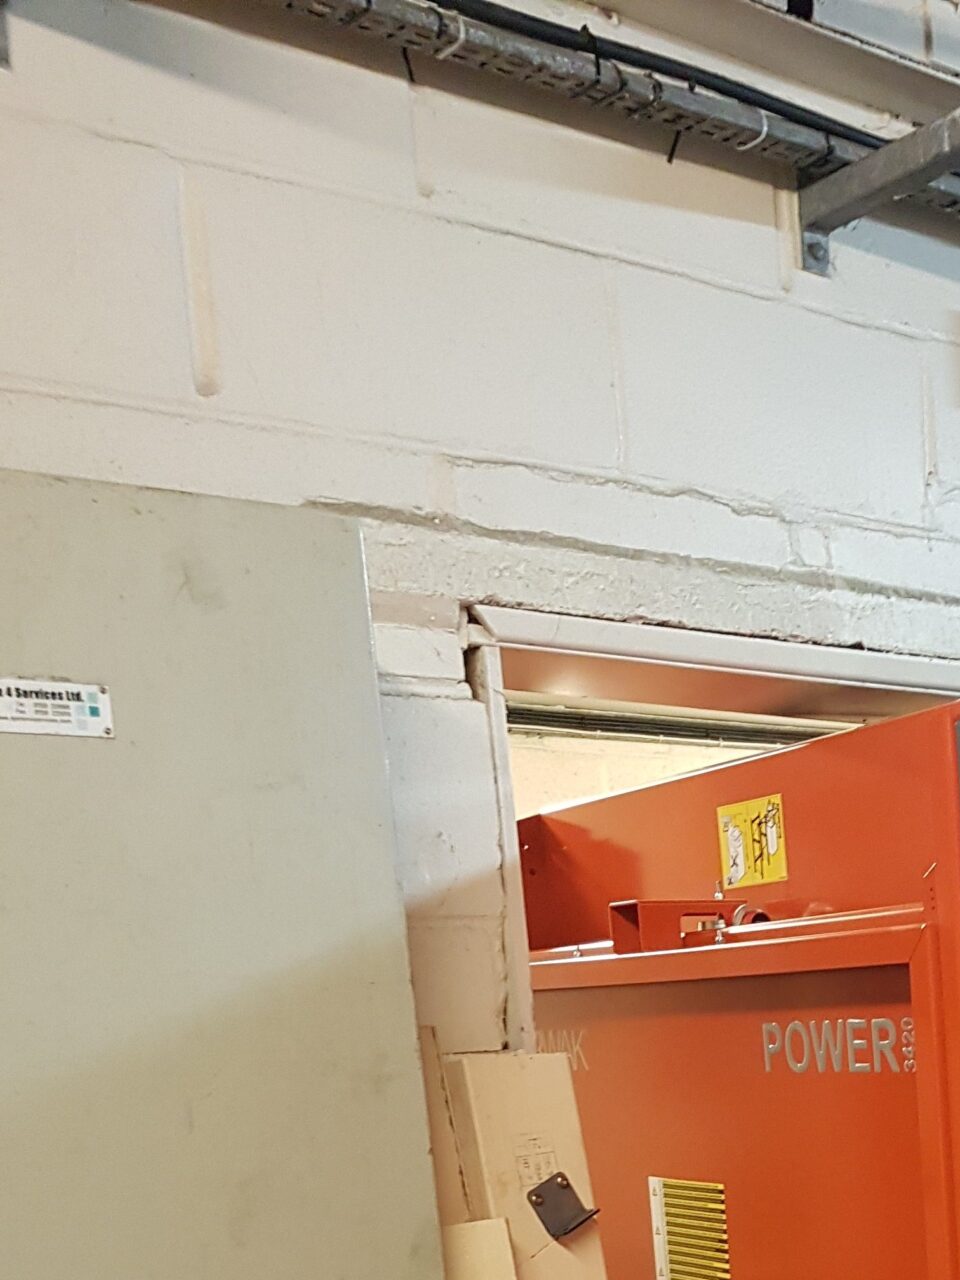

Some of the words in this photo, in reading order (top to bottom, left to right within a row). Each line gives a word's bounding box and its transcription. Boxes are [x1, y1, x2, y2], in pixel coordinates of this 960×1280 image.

[15, 687, 64, 701] Services
[65, 690, 85, 702] Ltd.
[763, 1016, 901, 1073] POWER
[900, 1016, 917, 1073] 3420
